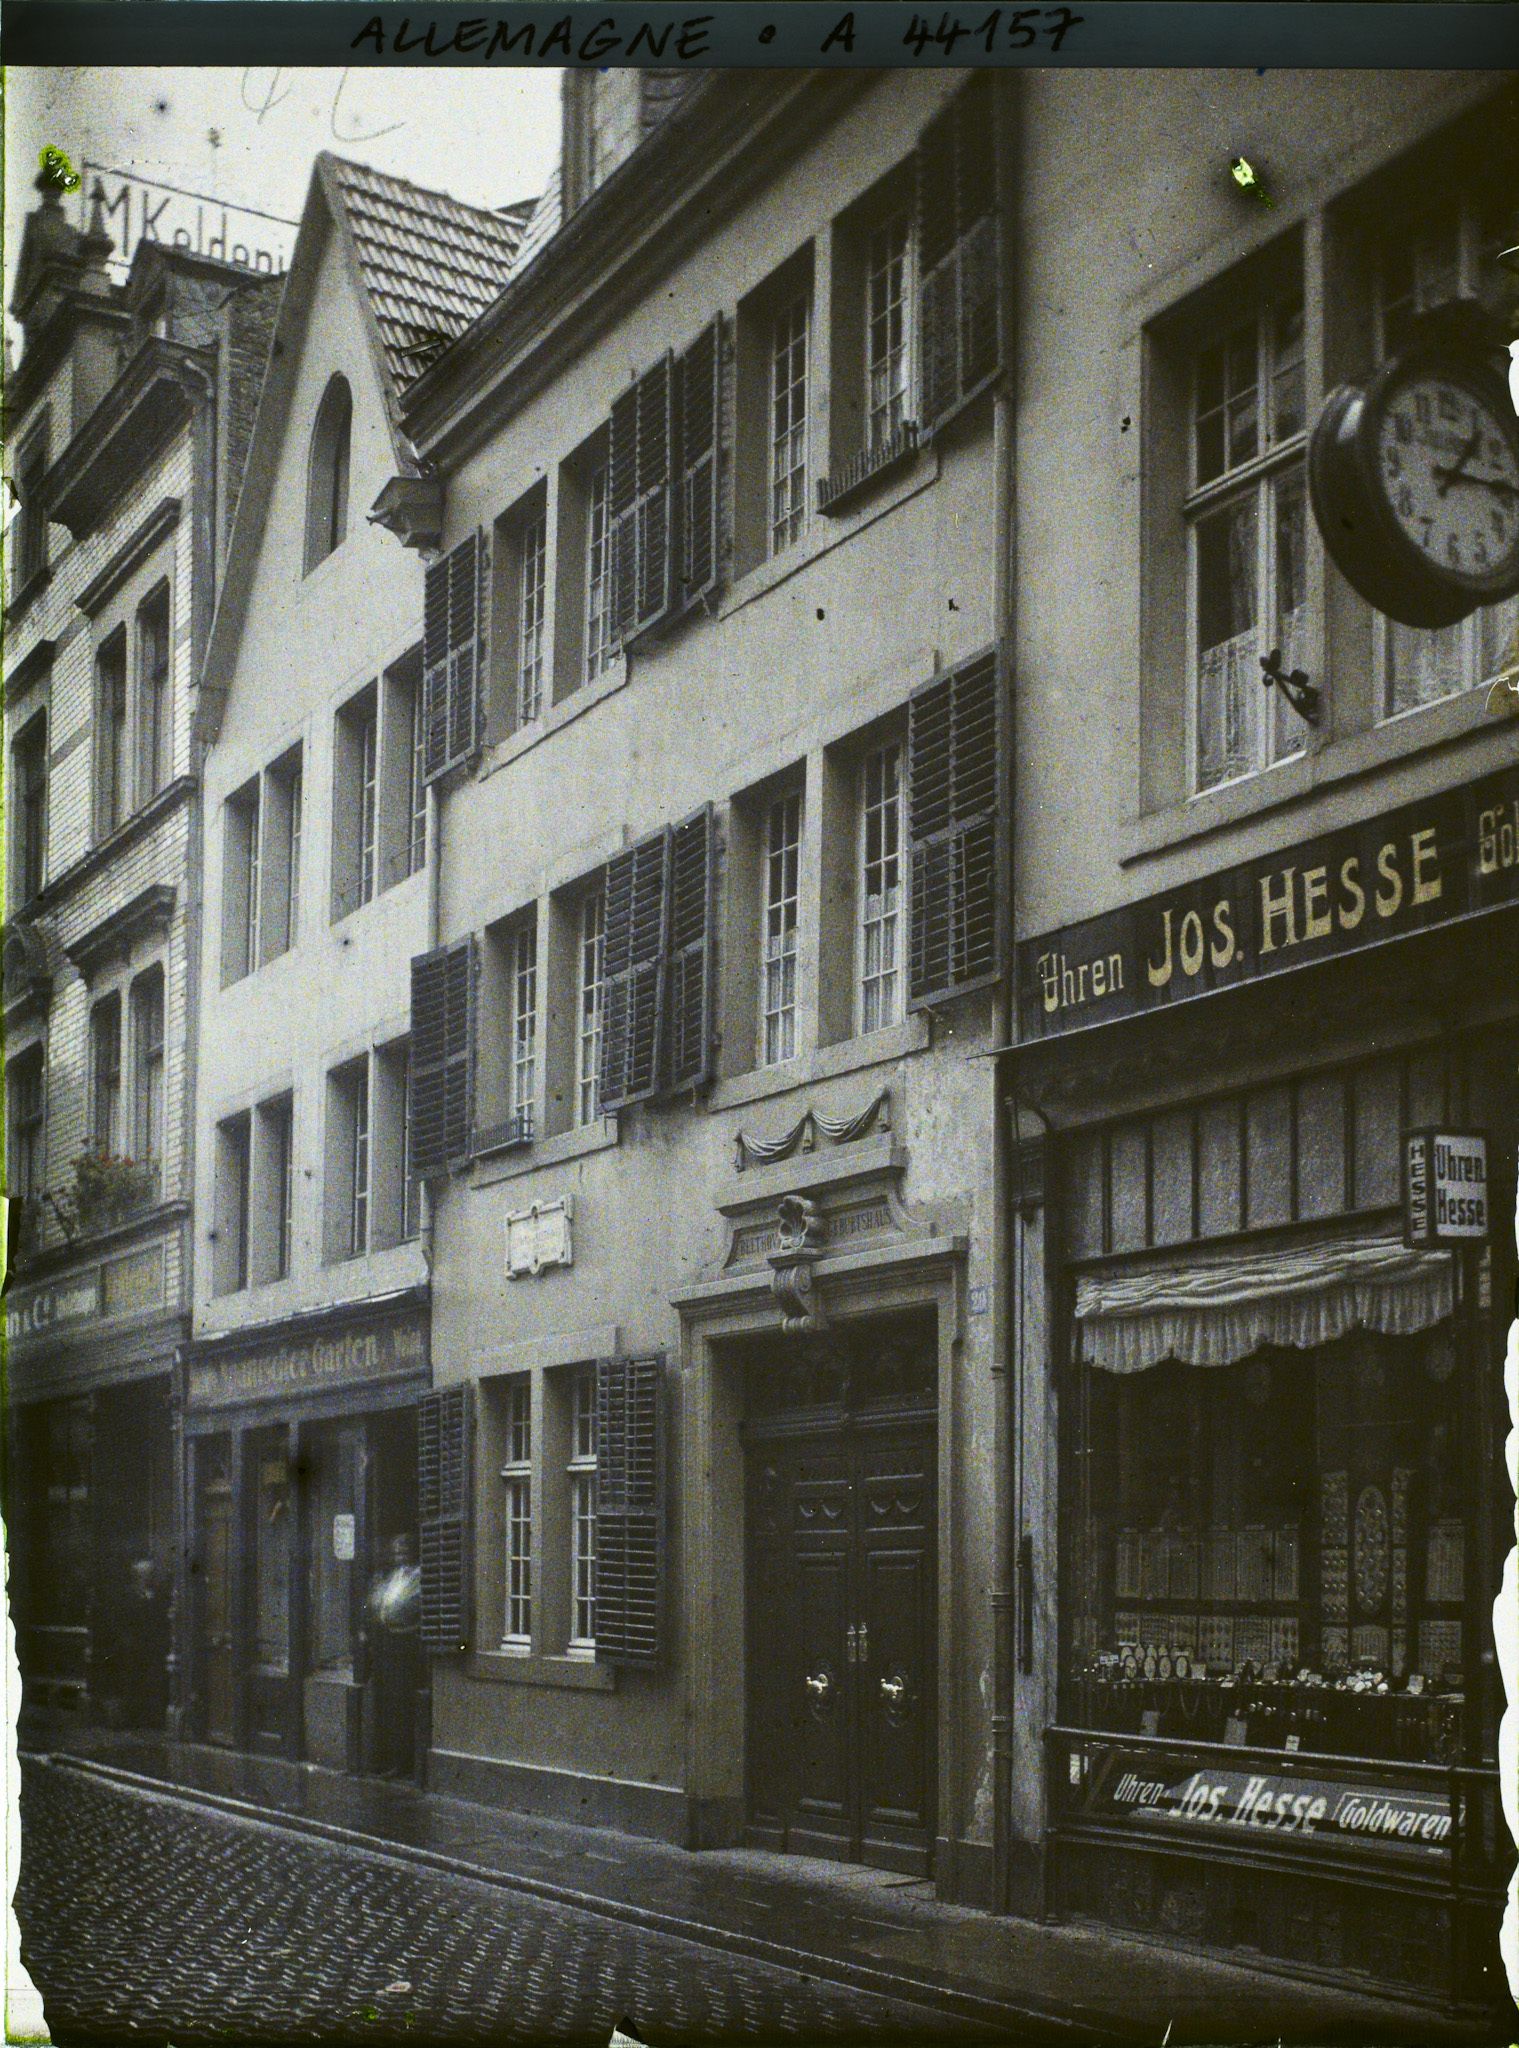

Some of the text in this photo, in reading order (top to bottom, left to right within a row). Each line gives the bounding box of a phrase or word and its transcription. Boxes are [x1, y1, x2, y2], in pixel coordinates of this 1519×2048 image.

[351, 8, 1085, 60] ALLEMAGNE A 44157
[1036, 950, 1124, 1013] Uhren
[1259, 827, 1443, 955] HESSE
[1411, 1144, 1426, 1231] HESSE
[1436, 1144, 1486, 1183] Uhren
[1436, 1188, 1486, 1226] Hesse
[1230, 1776, 1328, 1835] Hesse
[1338, 1798, 1453, 1841] Goldwaren
